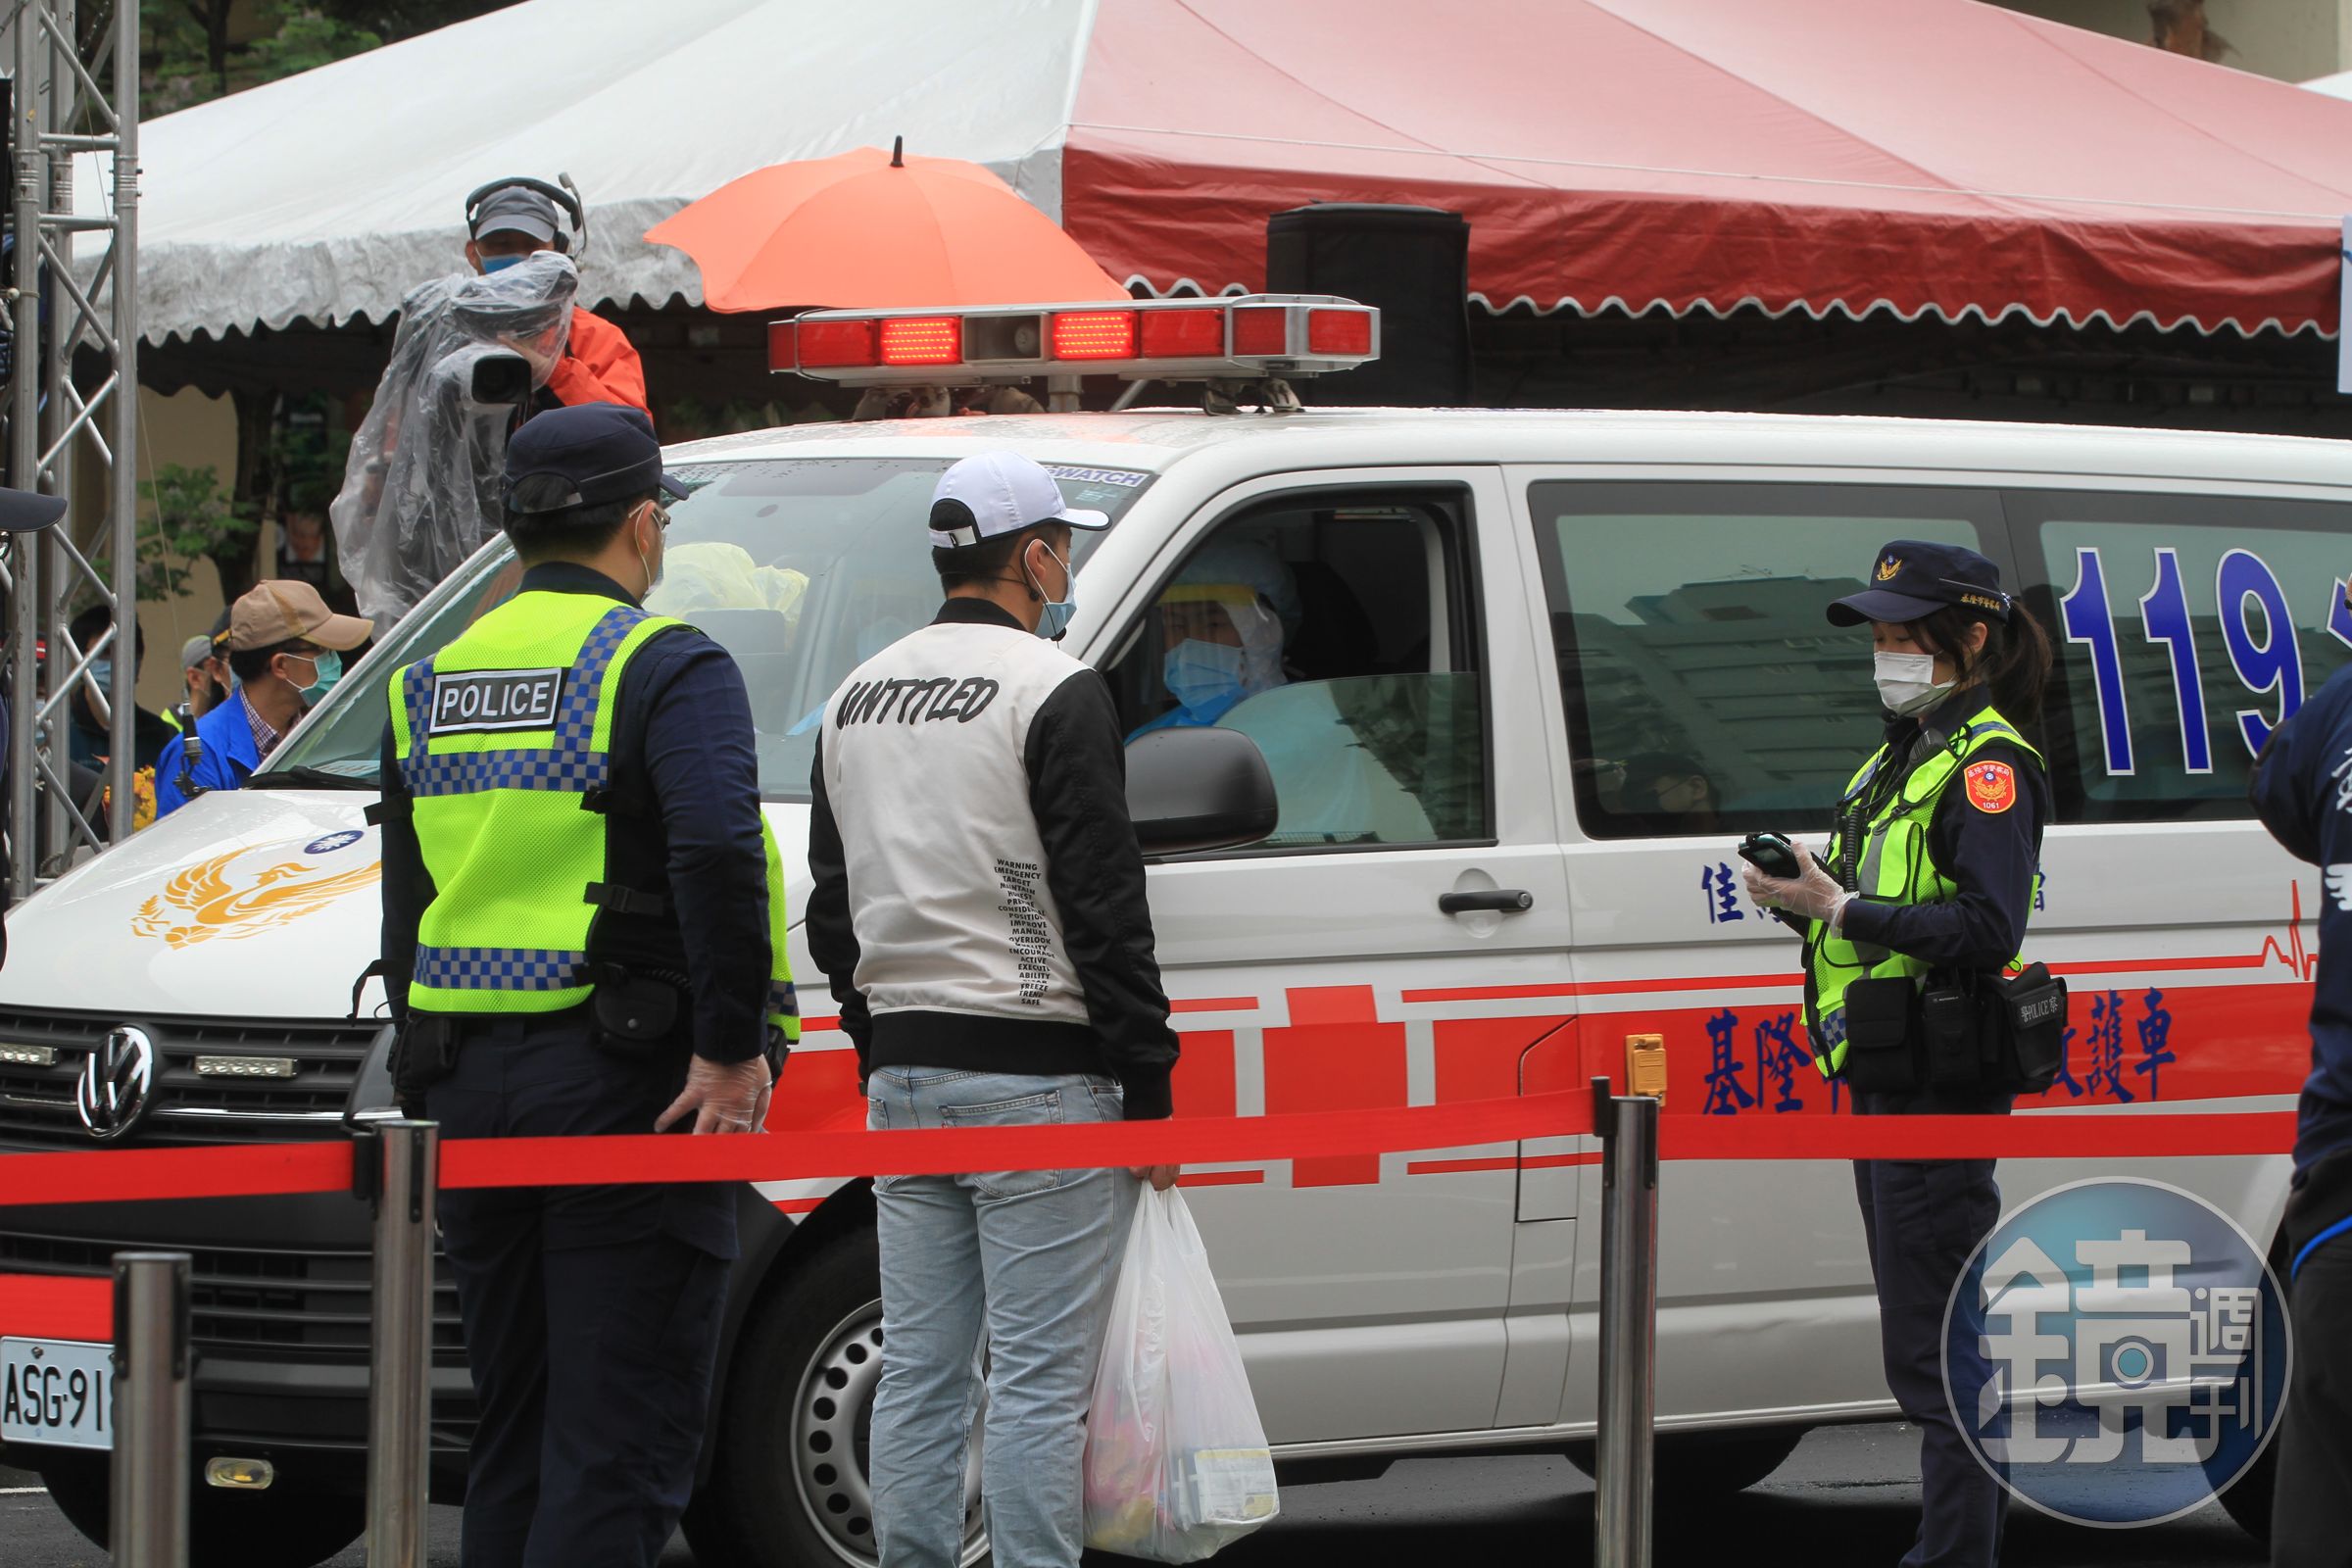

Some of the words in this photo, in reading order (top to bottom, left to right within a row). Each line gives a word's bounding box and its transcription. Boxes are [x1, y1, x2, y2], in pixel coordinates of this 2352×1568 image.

[2059, 547, 2305, 775] 119
[440, 681, 550, 720] POLICE
[836, 676, 1000, 730] UNTITLED
[997, 858, 1038, 871] WARNING
[994, 866, 1042, 880] EMERGENCY
[1003, 875, 1031, 887] TARGET
[1010, 919, 1047, 928] IMPROVE
[1012, 928, 1048, 937] MANUAL
[1008, 936, 1052, 945] OVERLOOK
[1020, 983, 1049, 992] FREEZE
[4, 1362, 115, 1431] ASG-91
